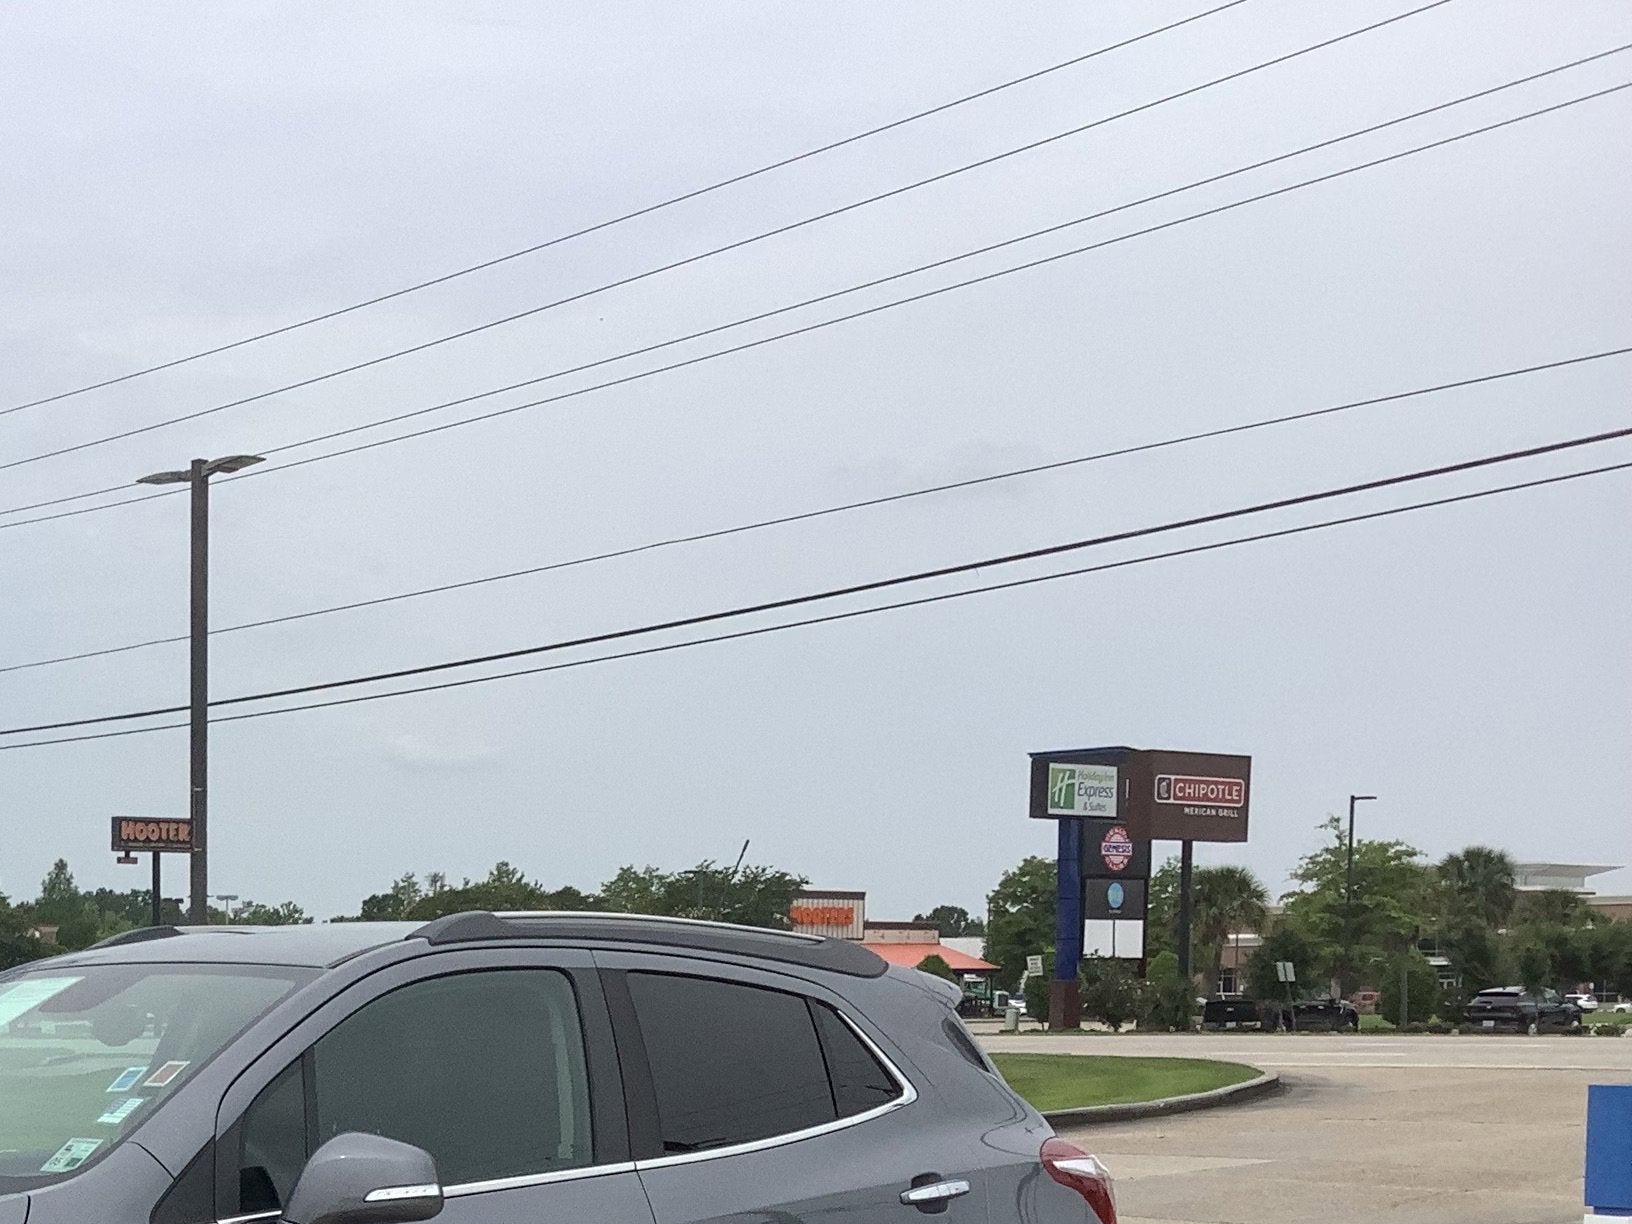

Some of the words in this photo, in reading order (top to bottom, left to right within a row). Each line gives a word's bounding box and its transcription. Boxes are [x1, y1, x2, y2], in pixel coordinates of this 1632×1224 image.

[1077, 781, 1114, 801] Express
[1175, 782, 1241, 800] CHIPOTLE
[1183, 806, 1216, 816] MEXICAN
[1217, 808, 1239, 818] GRILL
[120, 820, 192, 842] HOOTER
